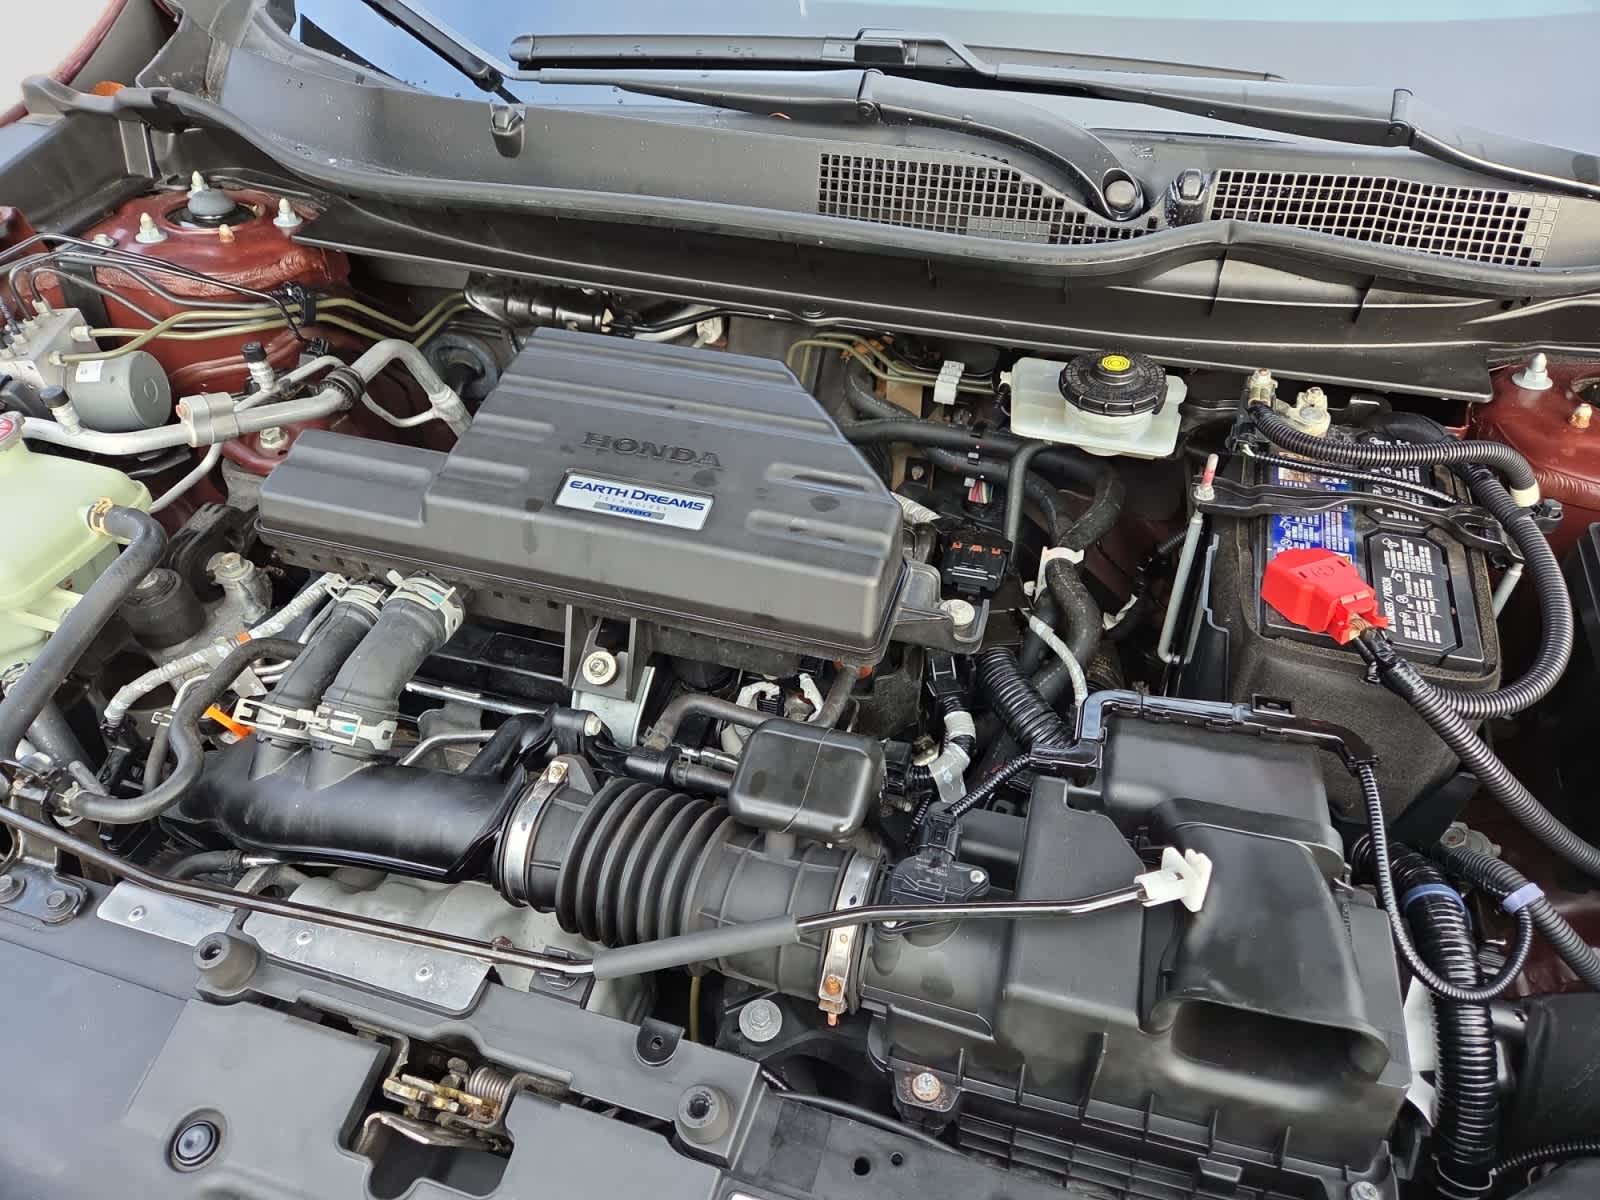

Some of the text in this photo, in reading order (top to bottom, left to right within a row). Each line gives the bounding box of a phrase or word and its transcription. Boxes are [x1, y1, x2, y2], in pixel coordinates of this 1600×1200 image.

[580, 432, 724, 470] HONDA
[570, 480, 705, 511] EARTH DREAMS
[607, 504, 652, 517] TURBO
